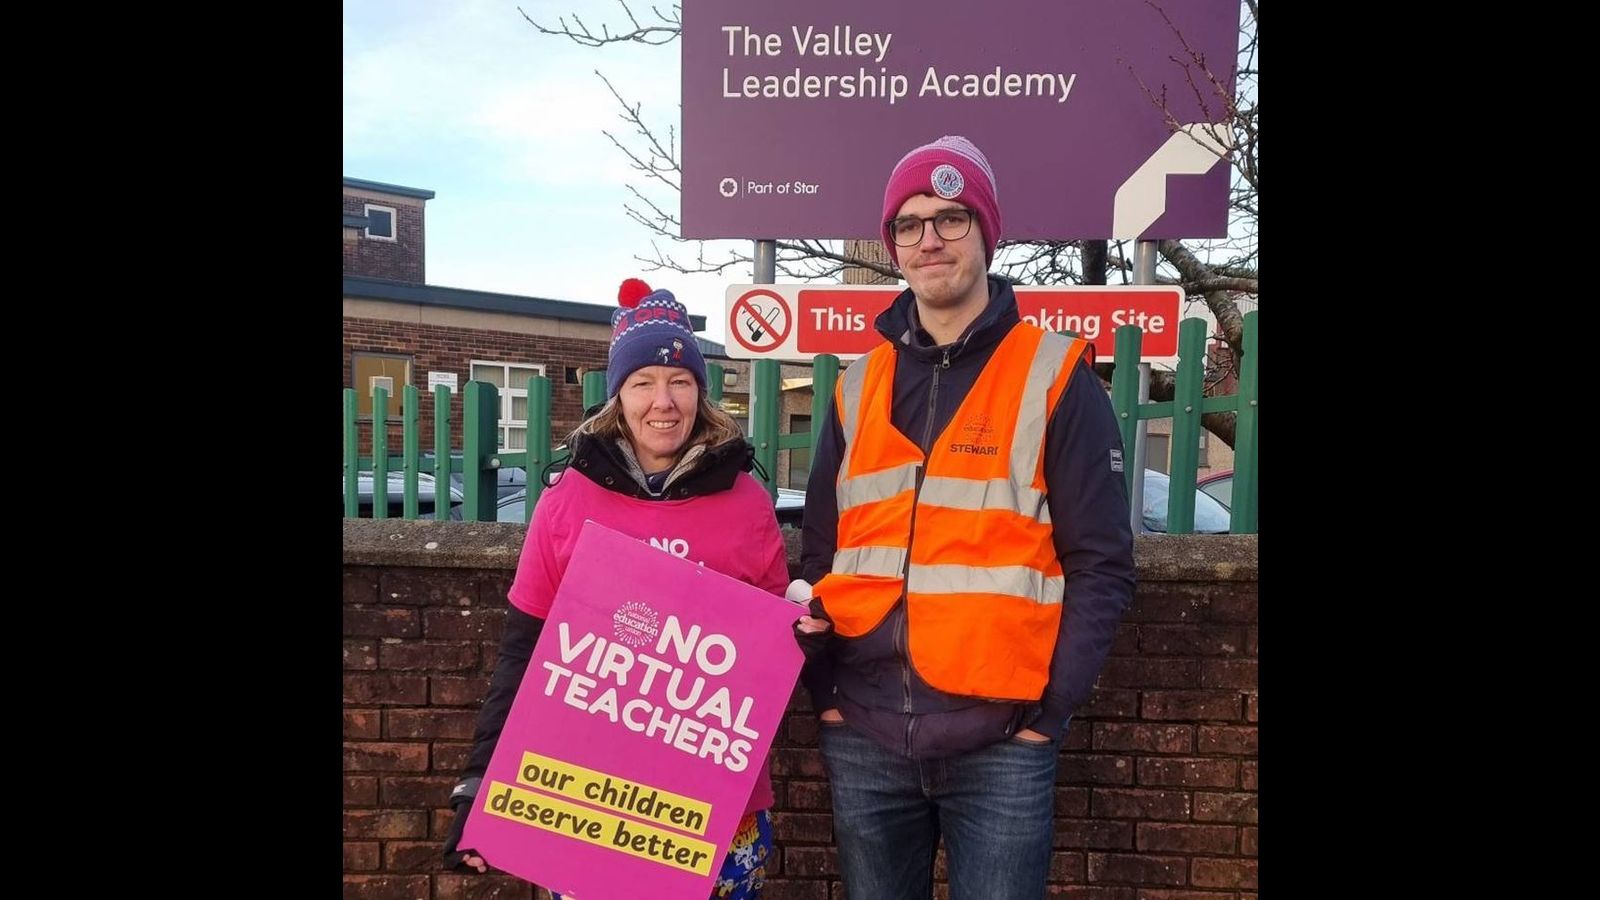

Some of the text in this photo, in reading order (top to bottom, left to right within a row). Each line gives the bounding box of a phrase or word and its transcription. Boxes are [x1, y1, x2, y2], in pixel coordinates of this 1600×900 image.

[721, 26, 893, 62] The Valley
[721, 66, 1077, 104] Leadership Academy
[747, 181, 819, 193] Part of Star
[634, 308, 681, 322] OFF
[810, 307, 866, 331] This
[1111, 309, 1165, 333] Site
[650, 537, 689, 558] NO
[613, 612, 659, 637] education
[655, 615, 737, 676] NO
[558, 622, 759, 740] VIRTUAL
[543, 661, 752, 773] TEACHERS
[522, 761, 704, 830] our children
[491, 788, 601, 839] deserve
[612, 820, 708, 869] better
